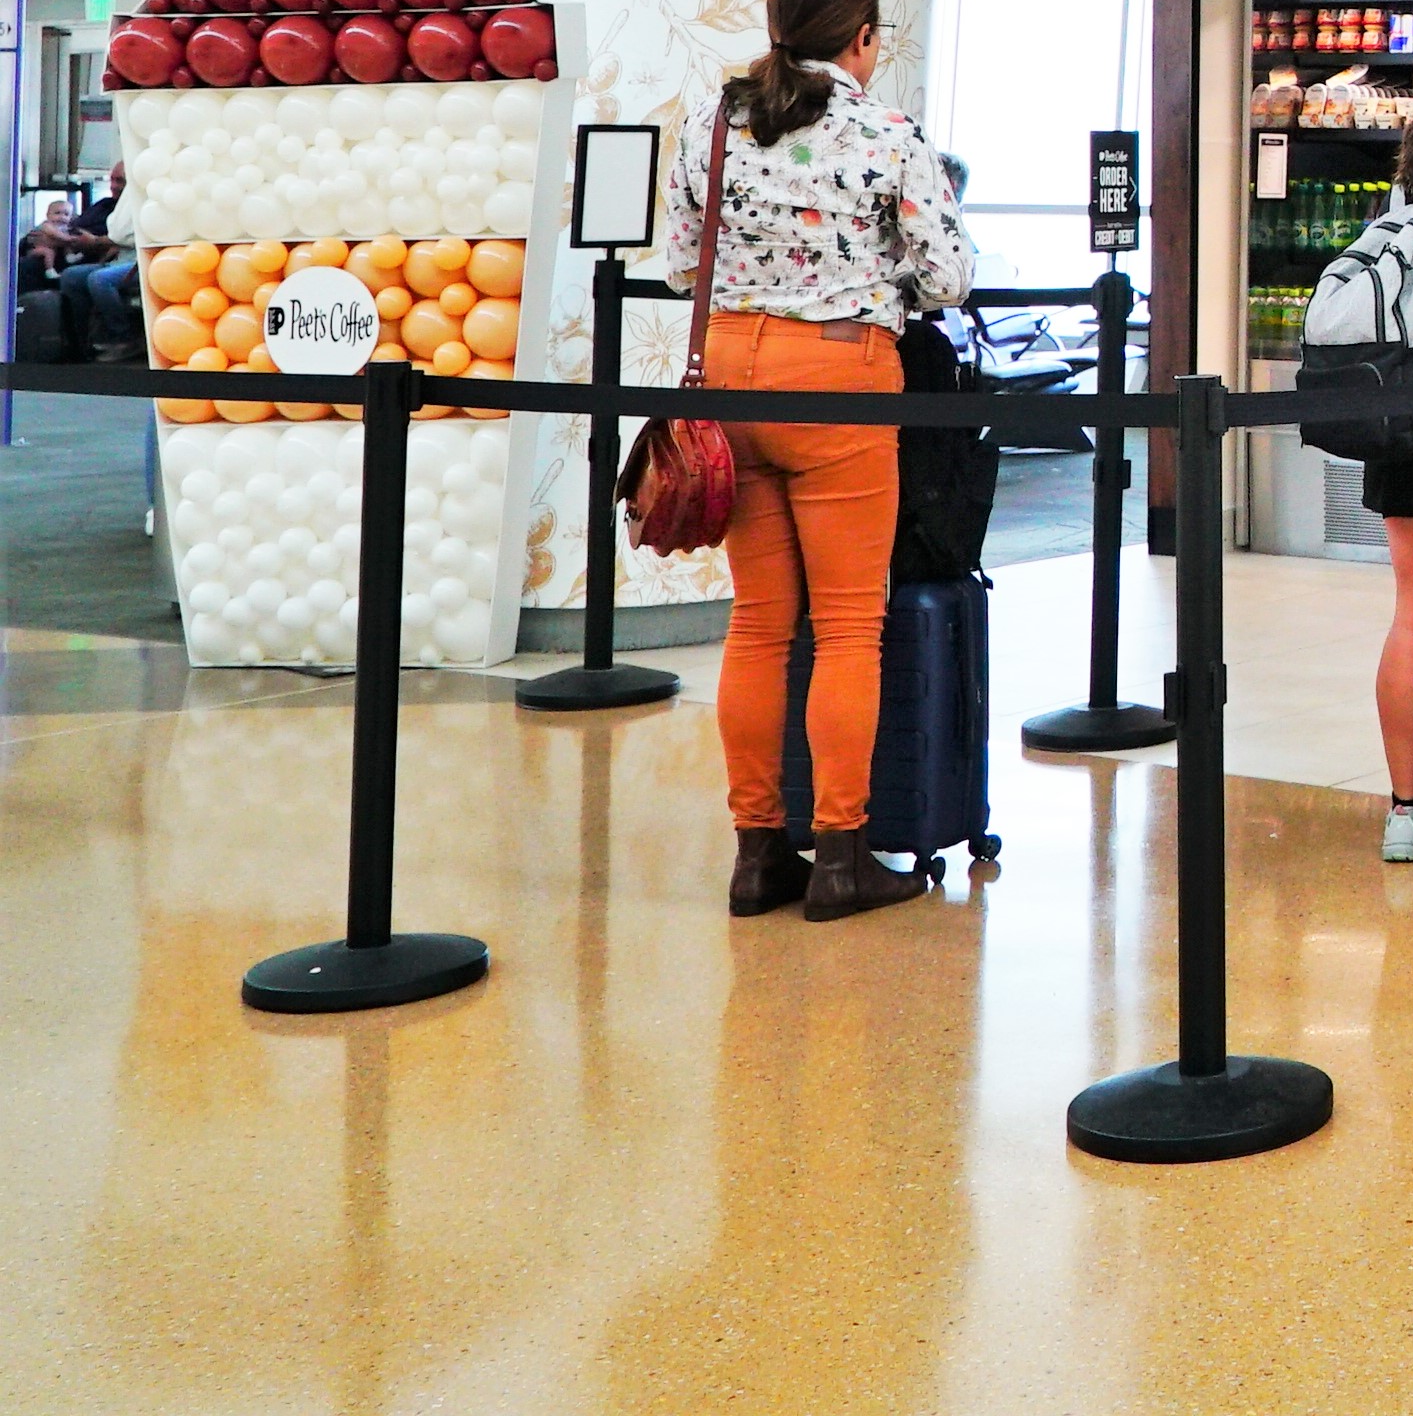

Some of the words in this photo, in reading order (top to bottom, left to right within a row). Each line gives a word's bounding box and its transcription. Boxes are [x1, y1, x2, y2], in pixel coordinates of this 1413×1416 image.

[1099, 166, 1128, 187] ORDER
[1099, 187, 1128, 213] HERE
[1094, 230, 1115, 246] CREDIT
[1118, 229, 1135, 244] DEBIT
[289, 298, 327, 342] Peet's
[330, 300, 374, 347] Coffee
